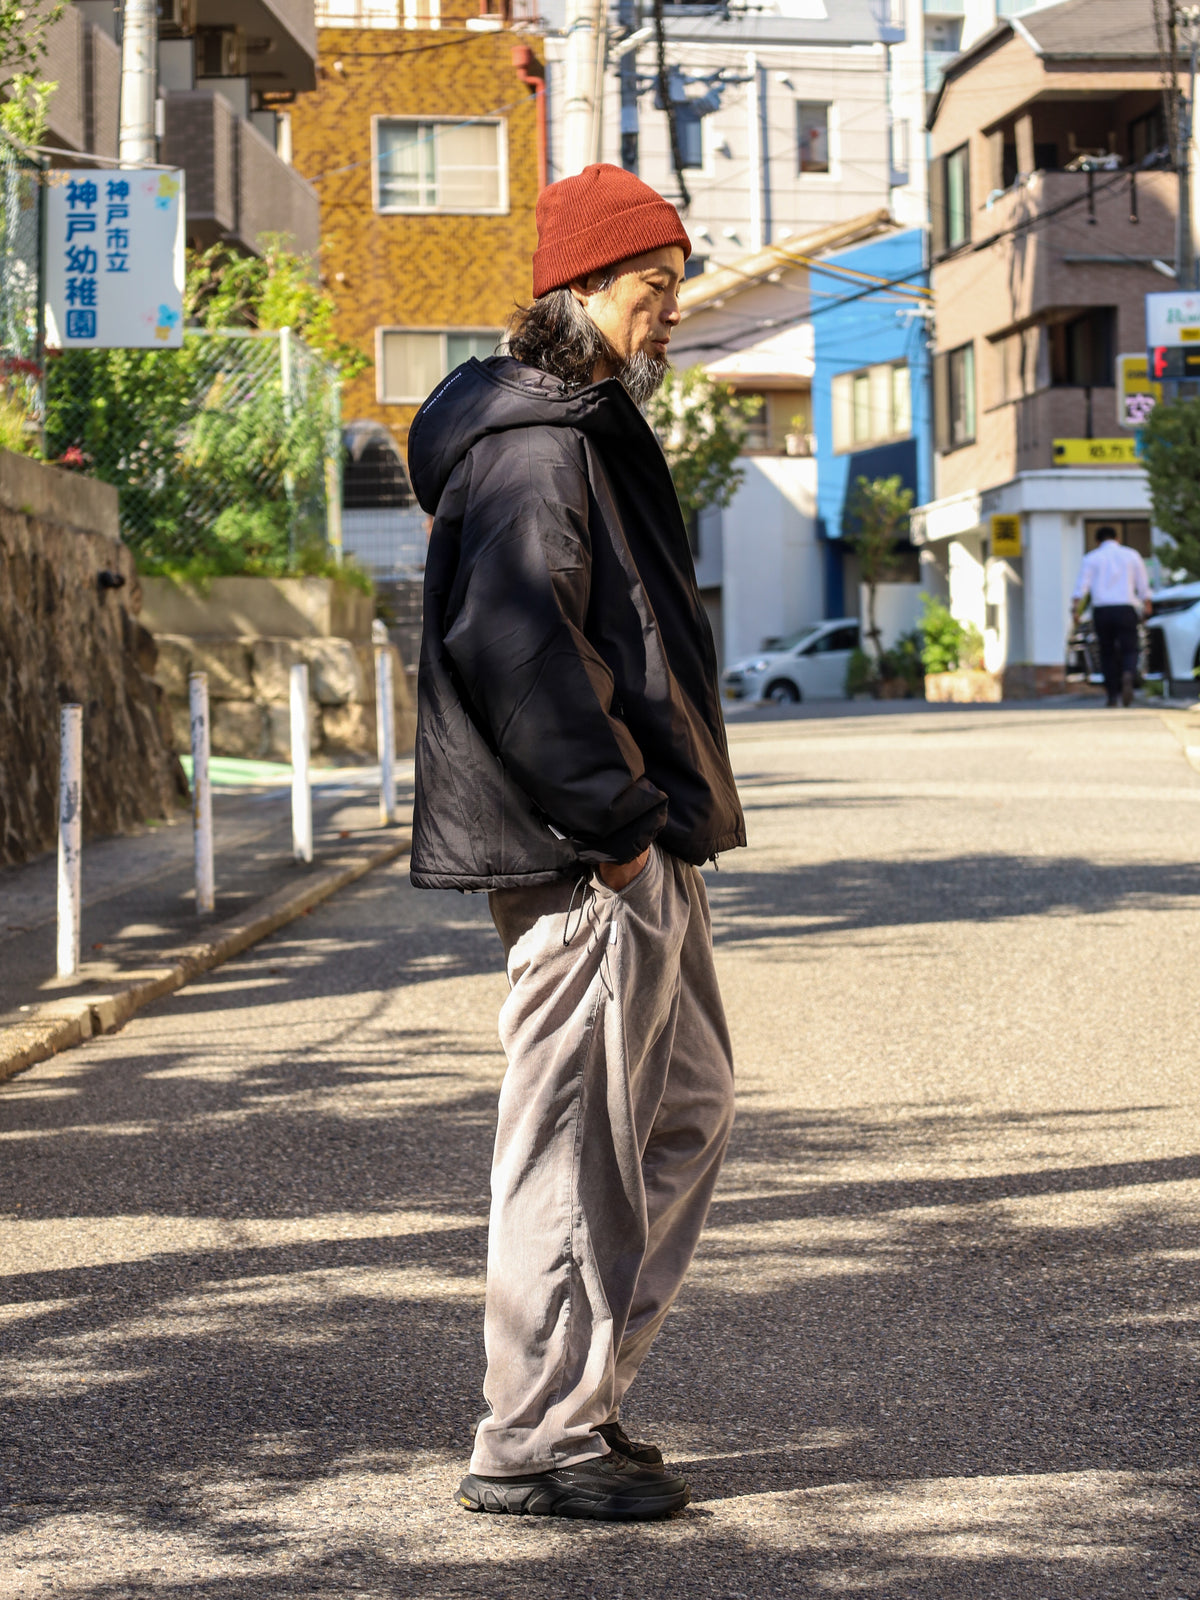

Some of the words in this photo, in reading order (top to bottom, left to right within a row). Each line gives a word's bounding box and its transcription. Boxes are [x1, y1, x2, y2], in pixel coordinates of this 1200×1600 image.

[64, 179, 98, 338] 神戸幼稚園
[105, 179, 131, 273] 神戸市立
